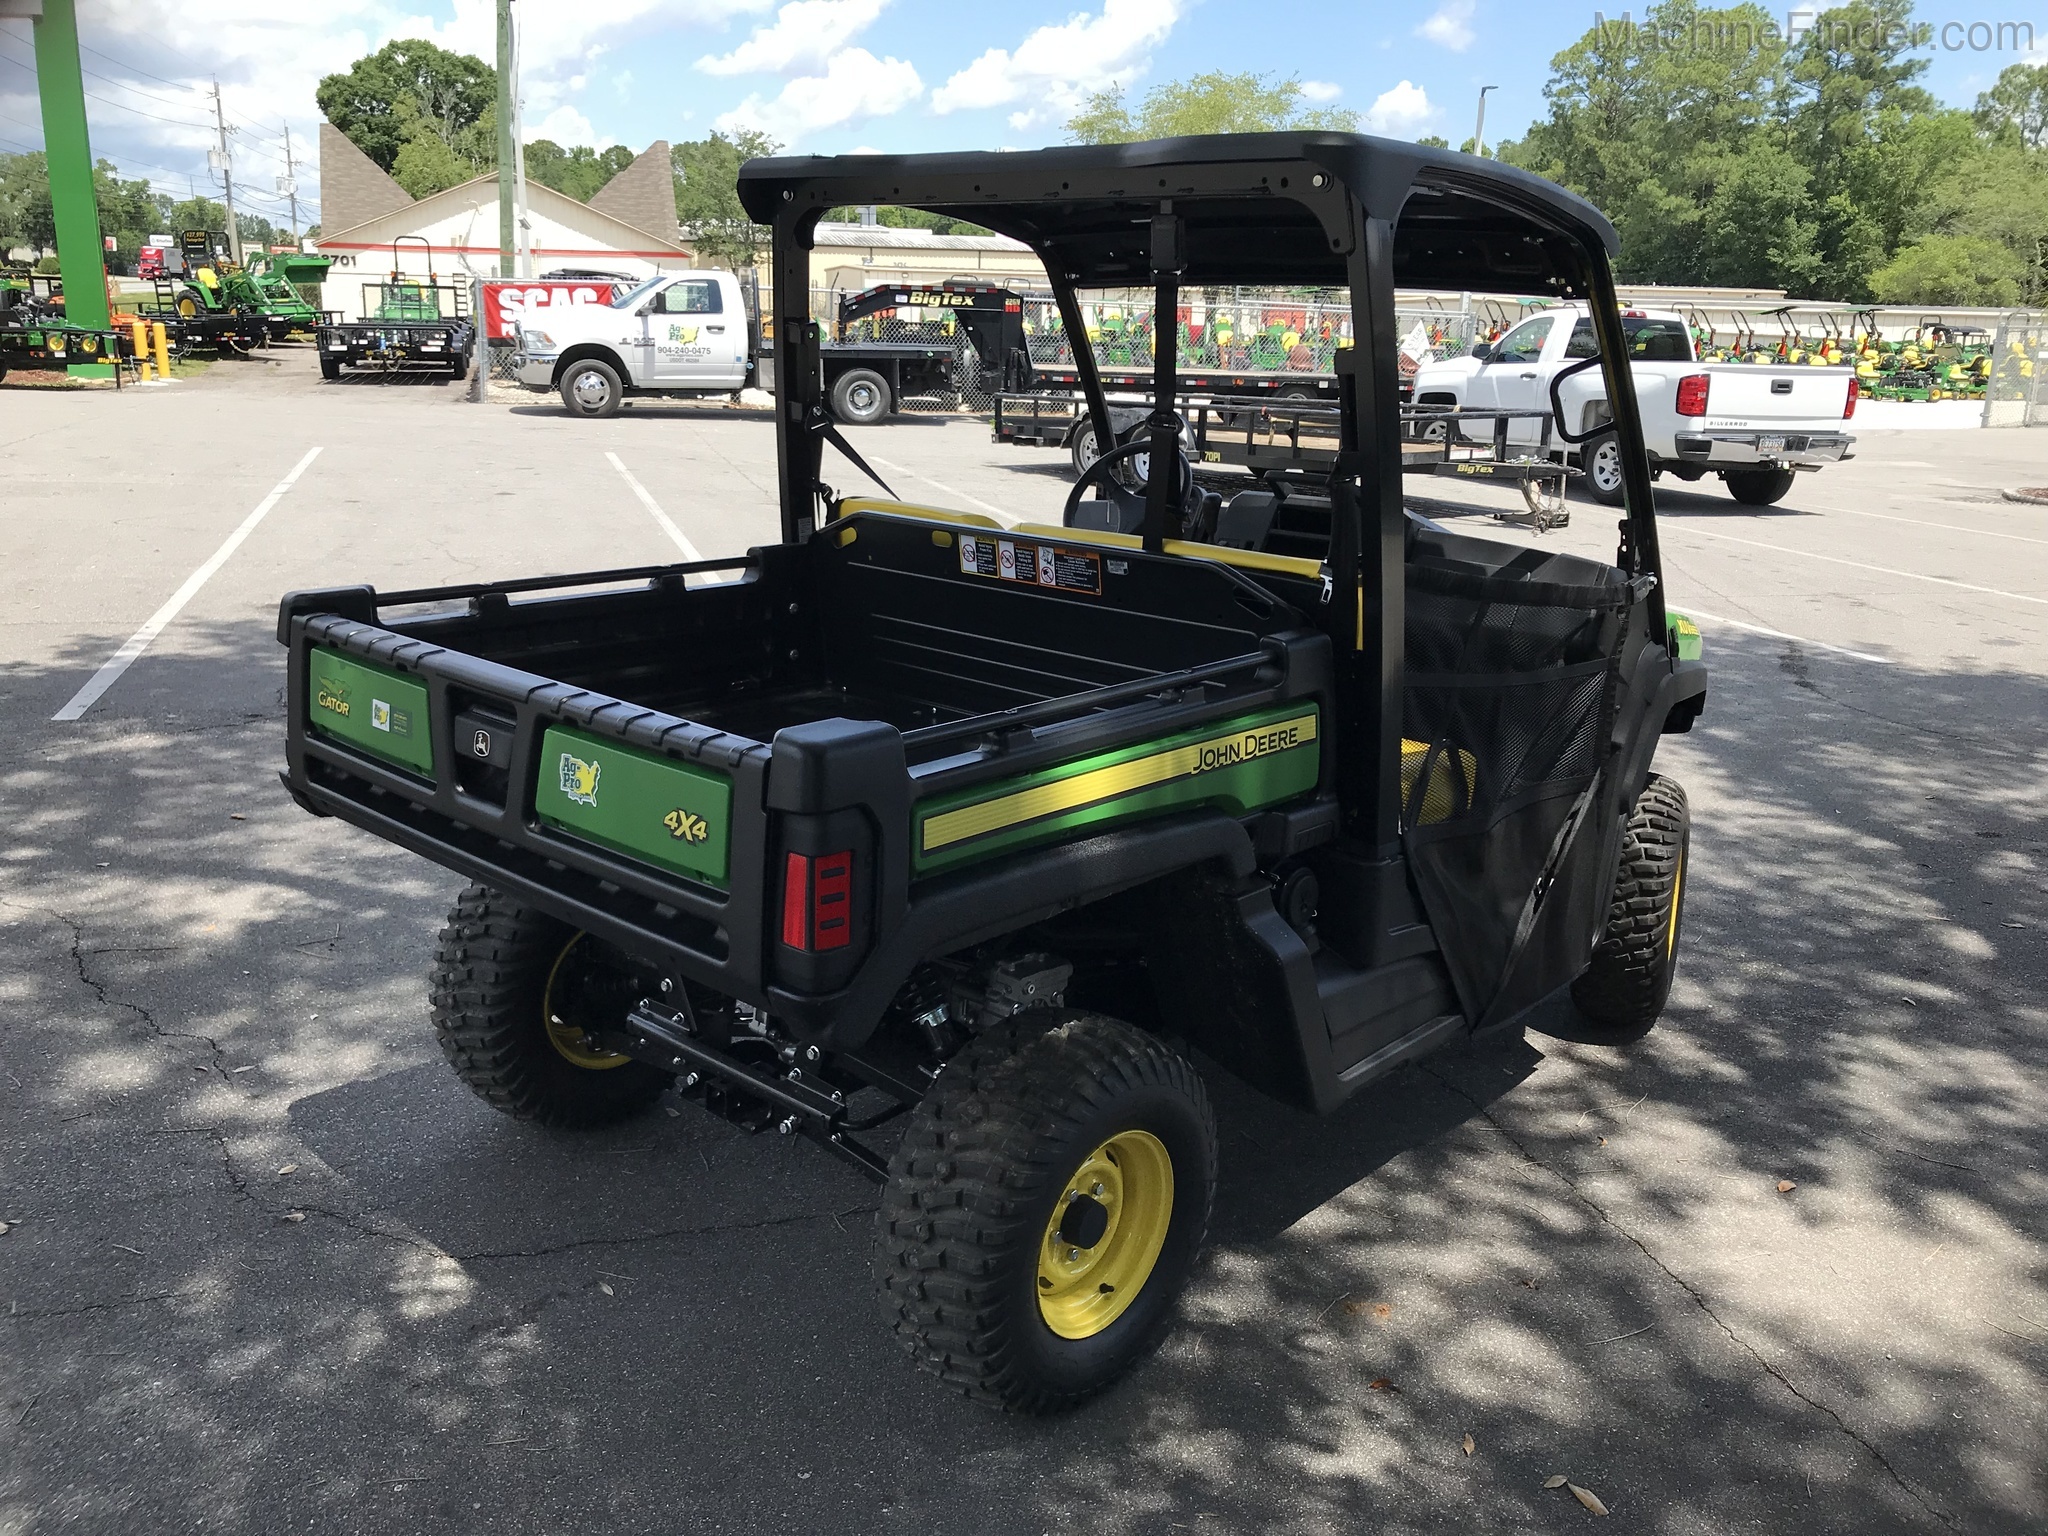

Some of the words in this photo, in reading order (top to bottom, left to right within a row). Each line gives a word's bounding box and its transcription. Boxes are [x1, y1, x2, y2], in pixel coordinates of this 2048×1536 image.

[909, 291, 976, 308] BigTex
[1005, 305, 1021, 313] HD
[669, 332, 685, 341] Pro
[656, 346, 712, 355] 904-240-0475
[1456, 464, 1494, 475] BigTex
[318, 691, 350, 717] GATOR
[1192, 741, 1241, 772] JOHN
[1244, 726, 1299, 757] DEERE
[562, 773, 581, 790] Pro
